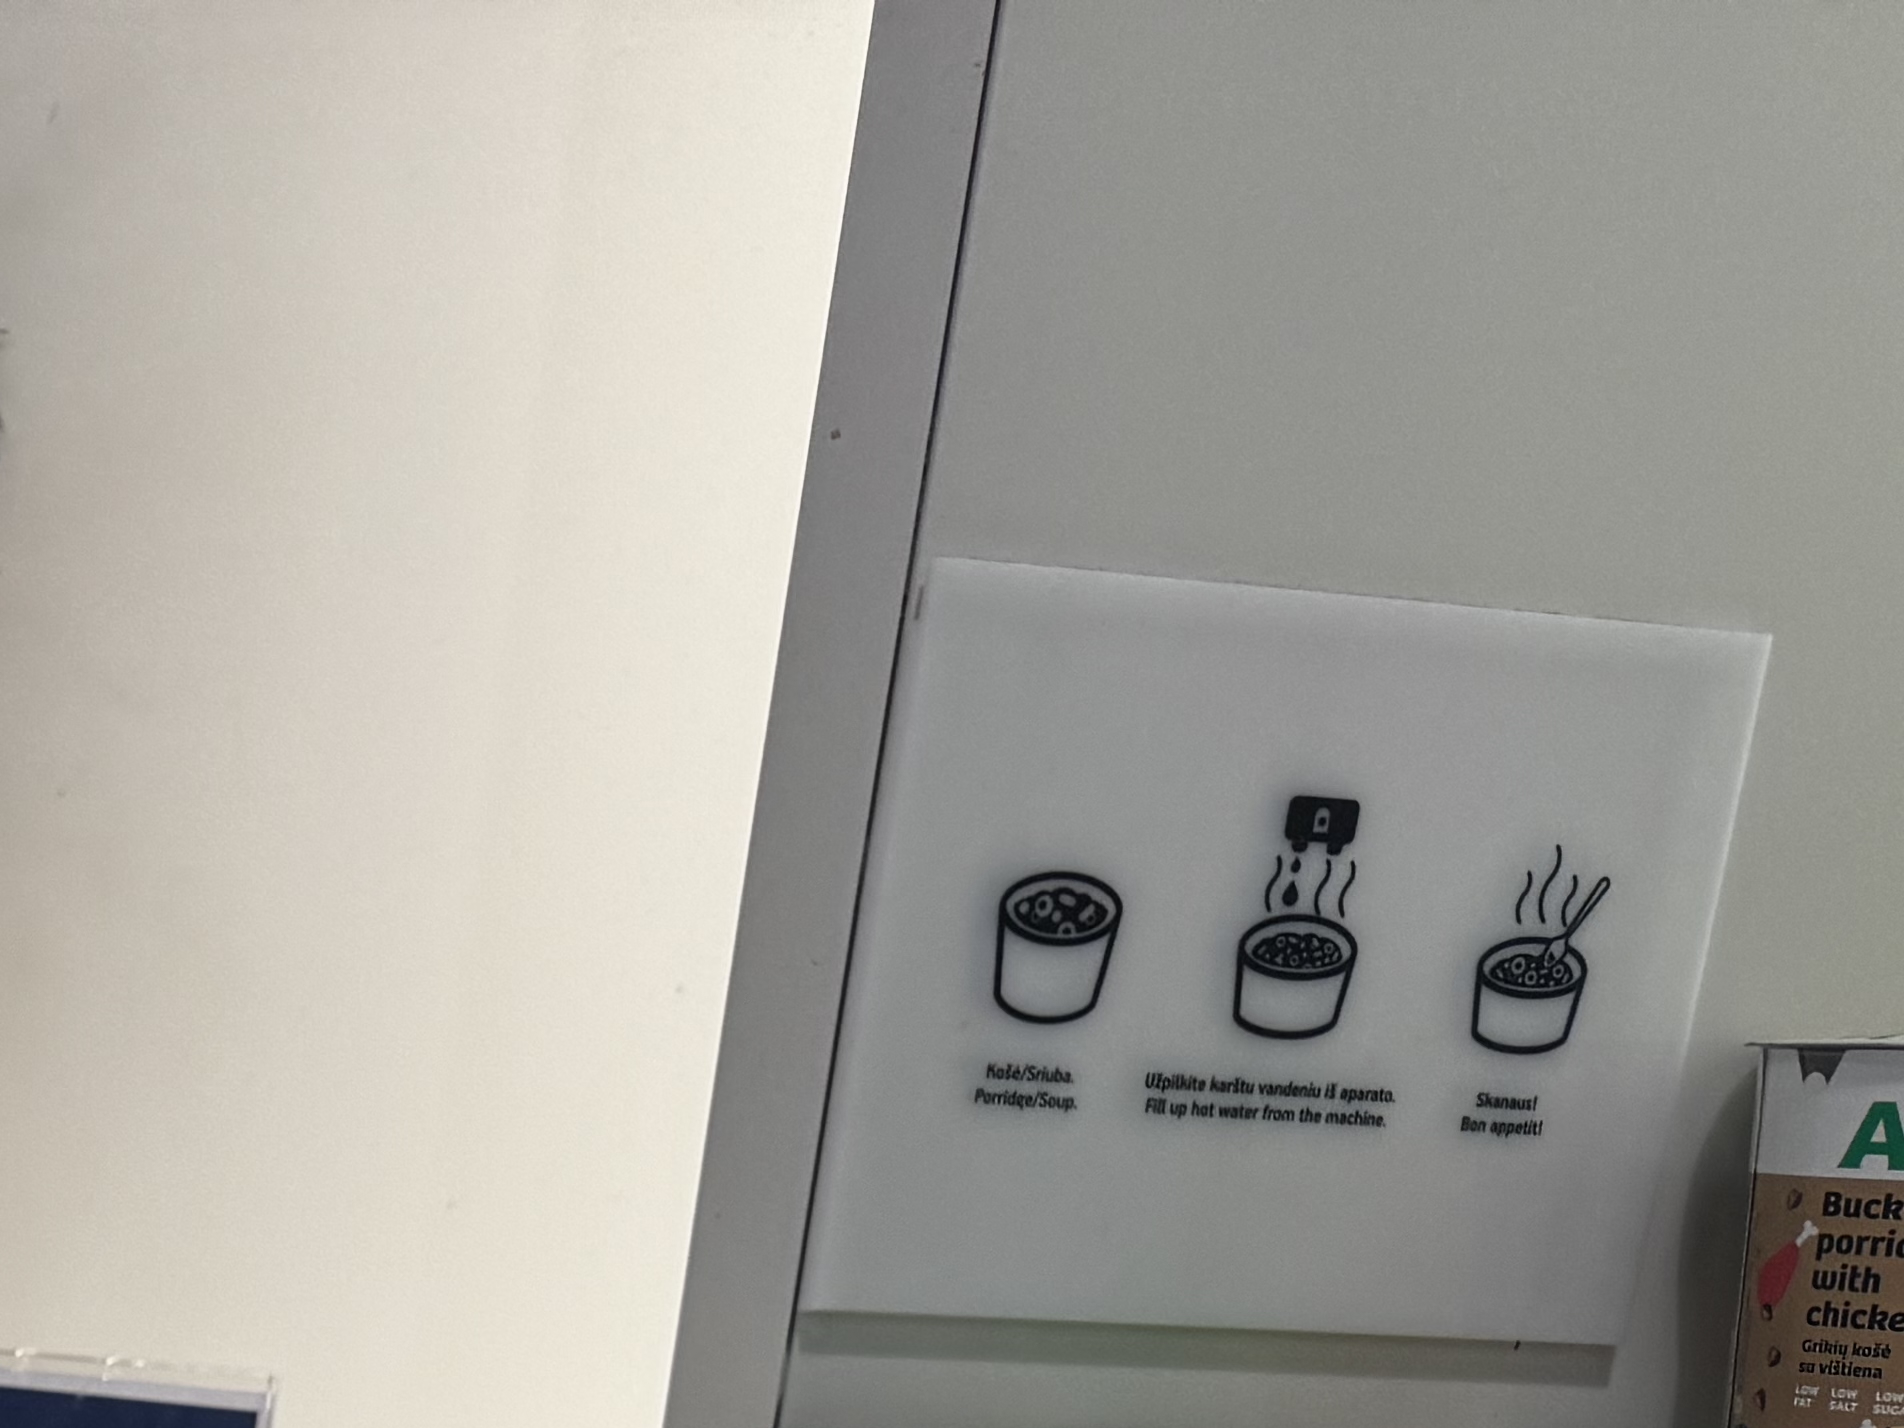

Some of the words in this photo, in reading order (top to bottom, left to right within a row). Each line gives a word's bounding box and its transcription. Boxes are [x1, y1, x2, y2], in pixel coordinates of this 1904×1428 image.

[974, 1087, 1077, 1112] Porridge/Soup.
[1258, 1080, 1321, 1099] vandeniu
[1476, 1091, 1538, 1112] Skanaus!
[1145, 1097, 1166, 1115] Fill
[1170, 1101, 1187, 1119] up
[1192, 1101, 1214, 1118] hot
[1218, 1104, 1259, 1121] water
[1262, 1104, 1295, 1122] from
[1299, 1107, 1322, 1124] the
[1325, 1110, 1386, 1128] machine.
[1460, 1115, 1486, 1133] Bon
[1811, 1266, 1882, 1293] with
[1831, 1387, 1858, 1400] LOW
